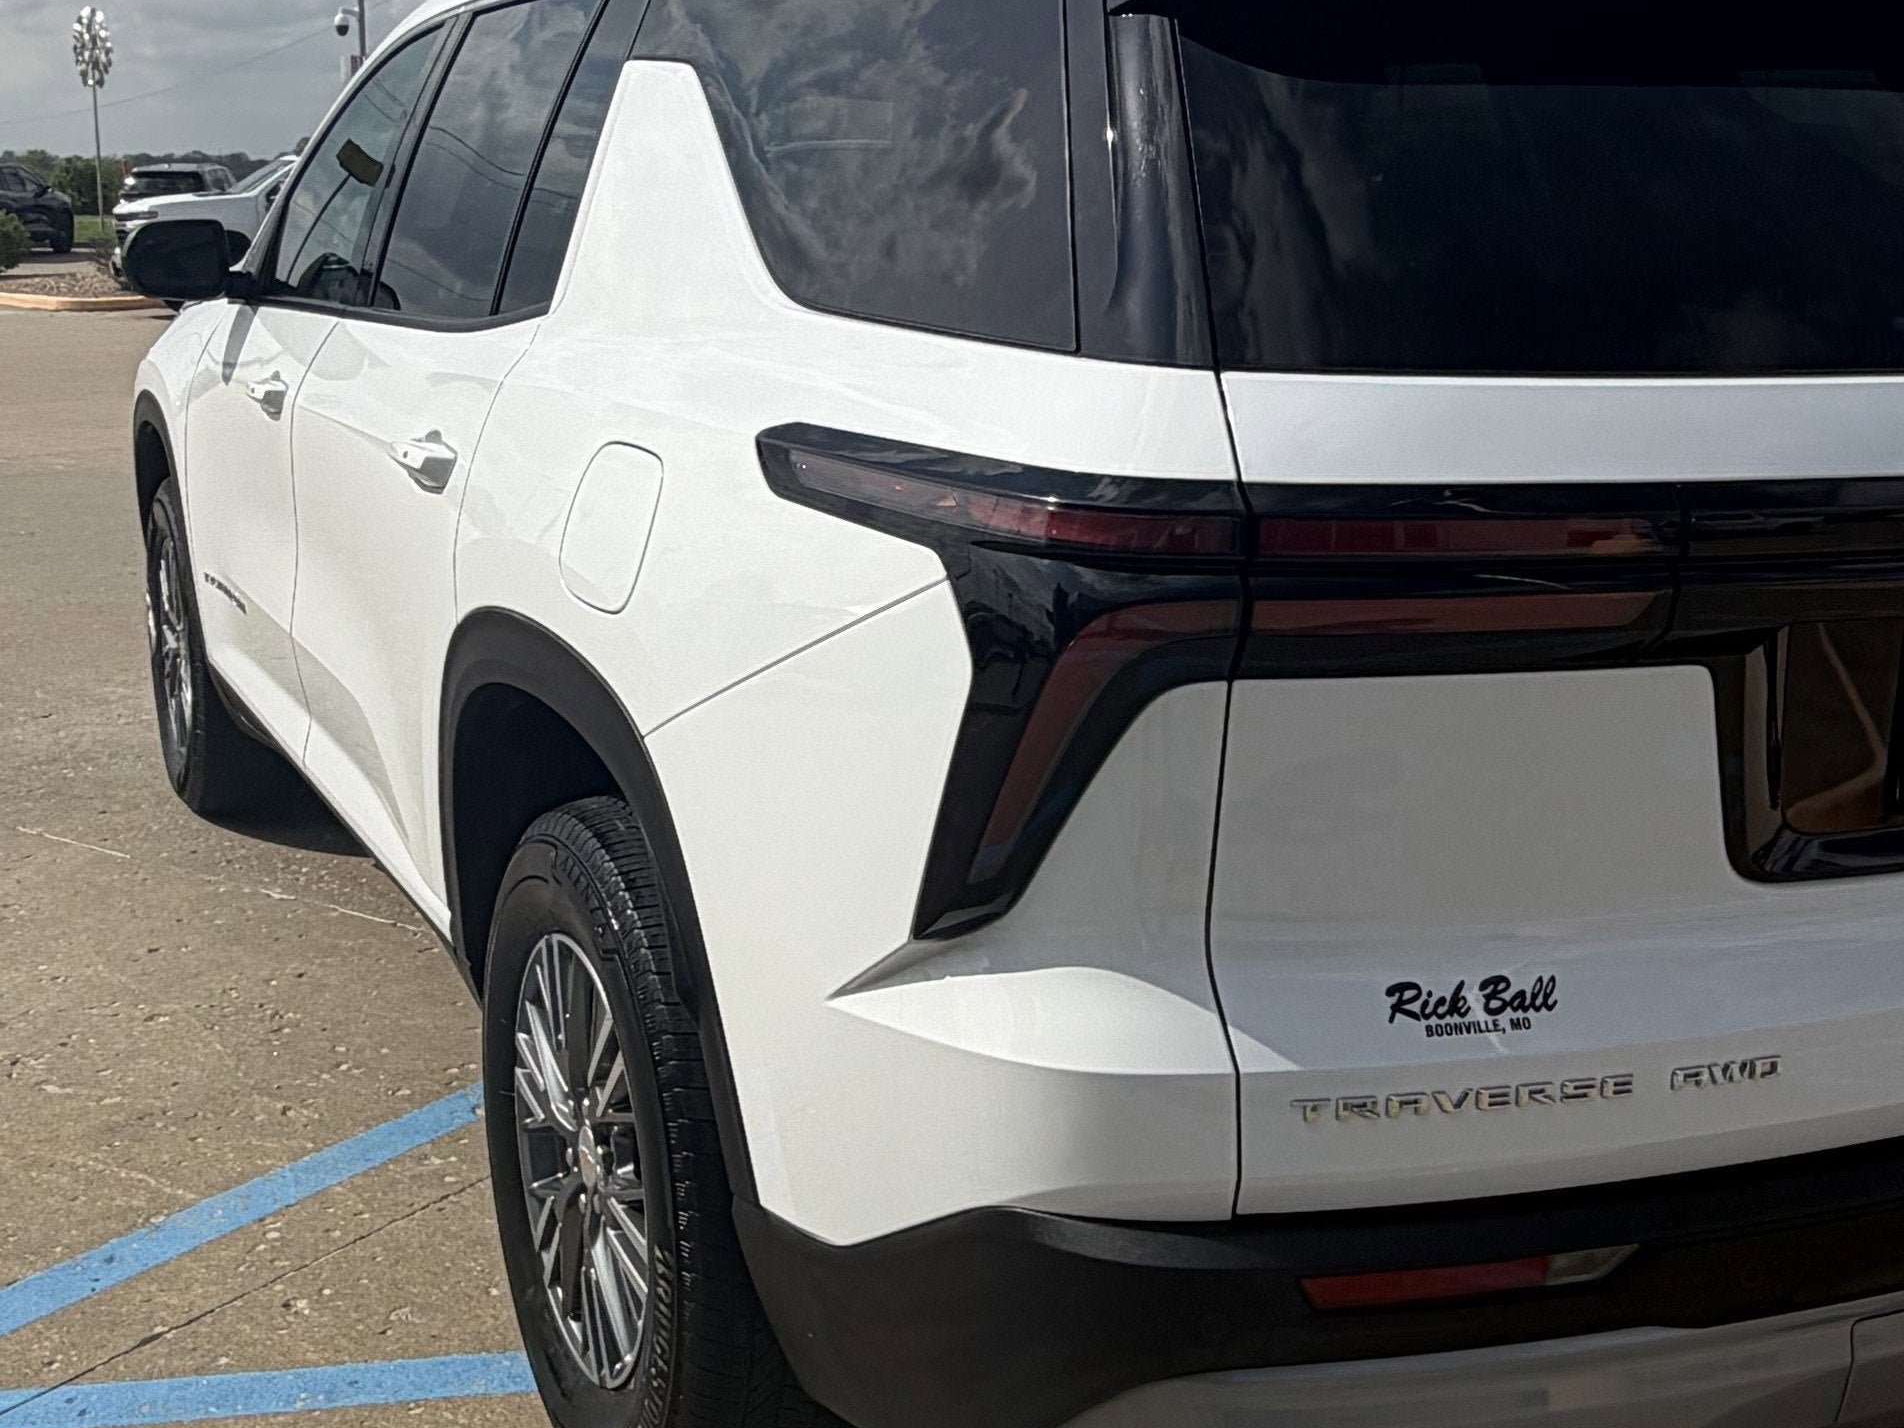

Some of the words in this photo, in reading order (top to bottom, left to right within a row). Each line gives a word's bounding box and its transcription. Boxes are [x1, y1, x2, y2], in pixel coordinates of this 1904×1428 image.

[1384, 980, 1472, 1025] Rick
[1478, 974, 1559, 1017] Ball
[1424, 1017, 1506, 1039] BOONVILLE,
[1509, 1016, 1533, 1032] MO
[1289, 1072, 1635, 1125] TRAVERSE
[1669, 1054, 1783, 1093] AWD
